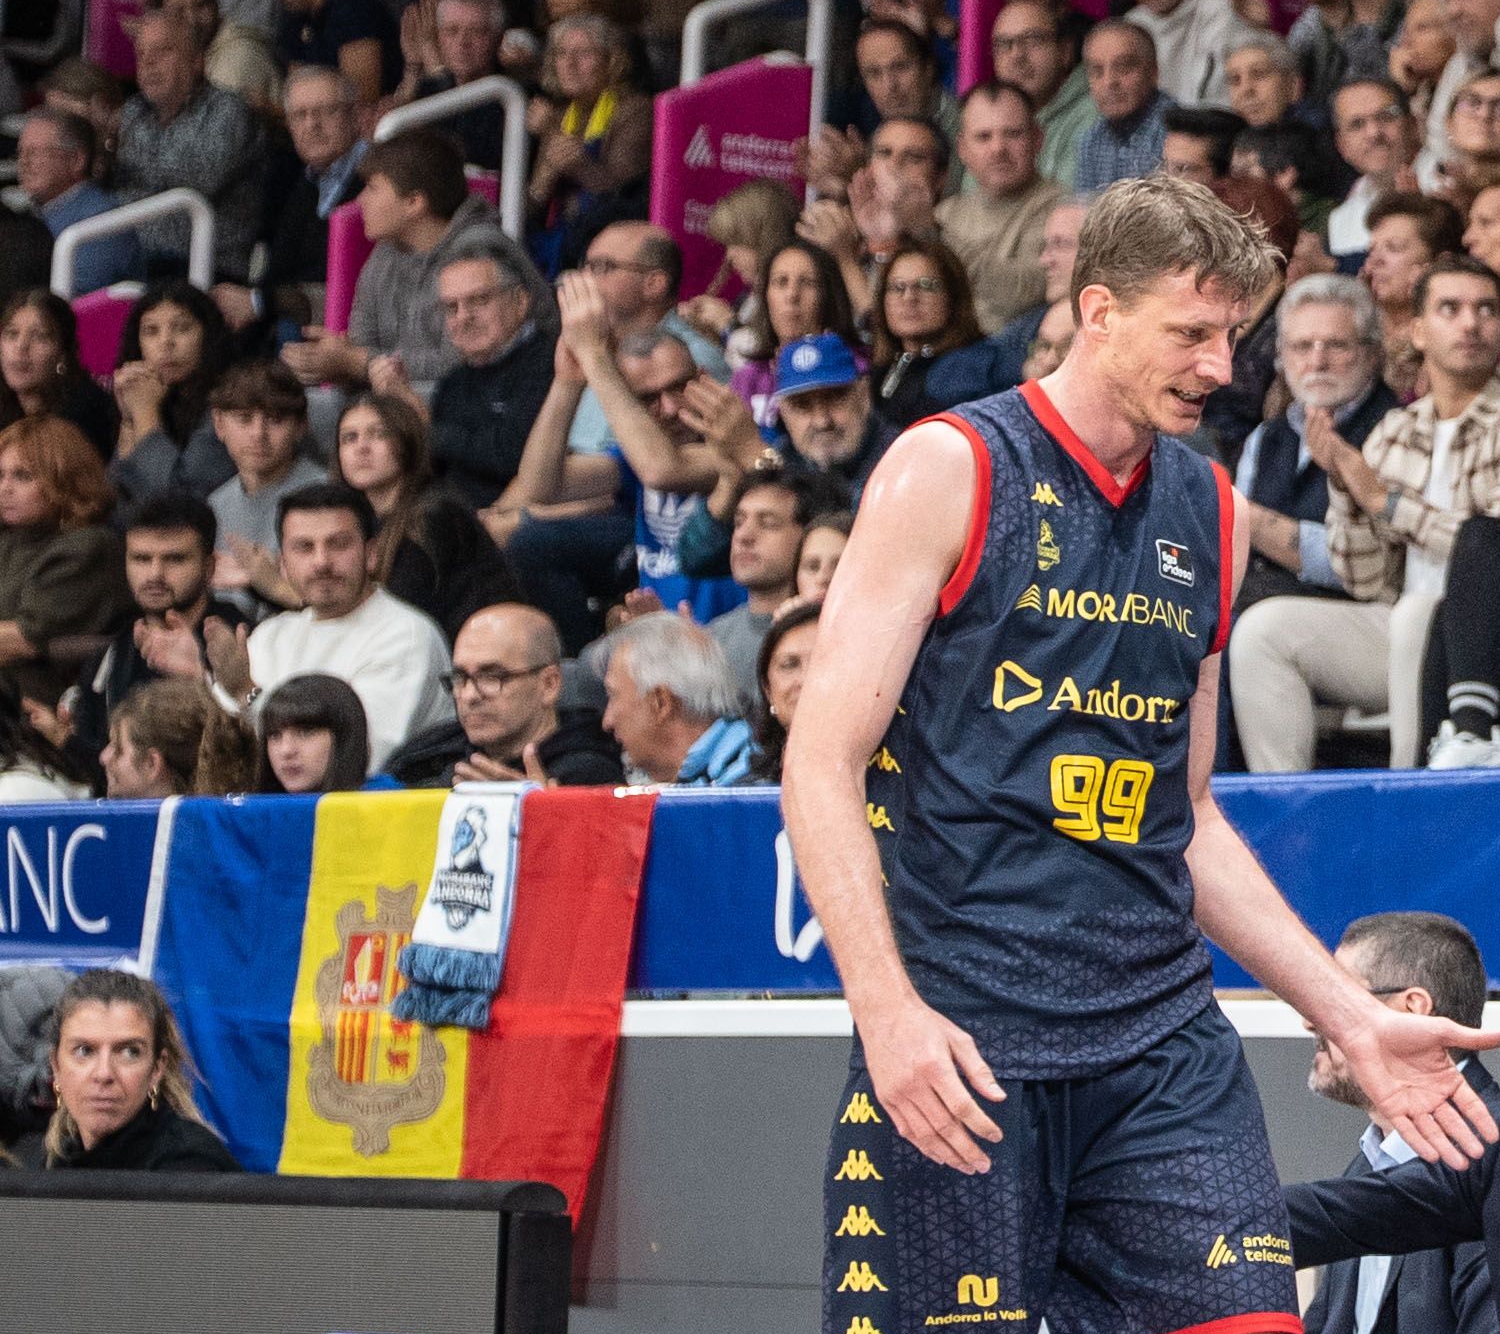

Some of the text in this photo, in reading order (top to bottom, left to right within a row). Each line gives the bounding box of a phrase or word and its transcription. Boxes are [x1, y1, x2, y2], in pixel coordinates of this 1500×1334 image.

[1047, 676, 1181, 724] Andorr
[1051, 755, 1152, 843] 99
[1242, 1234, 1291, 1251] andorra
[925, 1312, 981, 1326] Andorra
[983, 1310, 998, 1322] la
